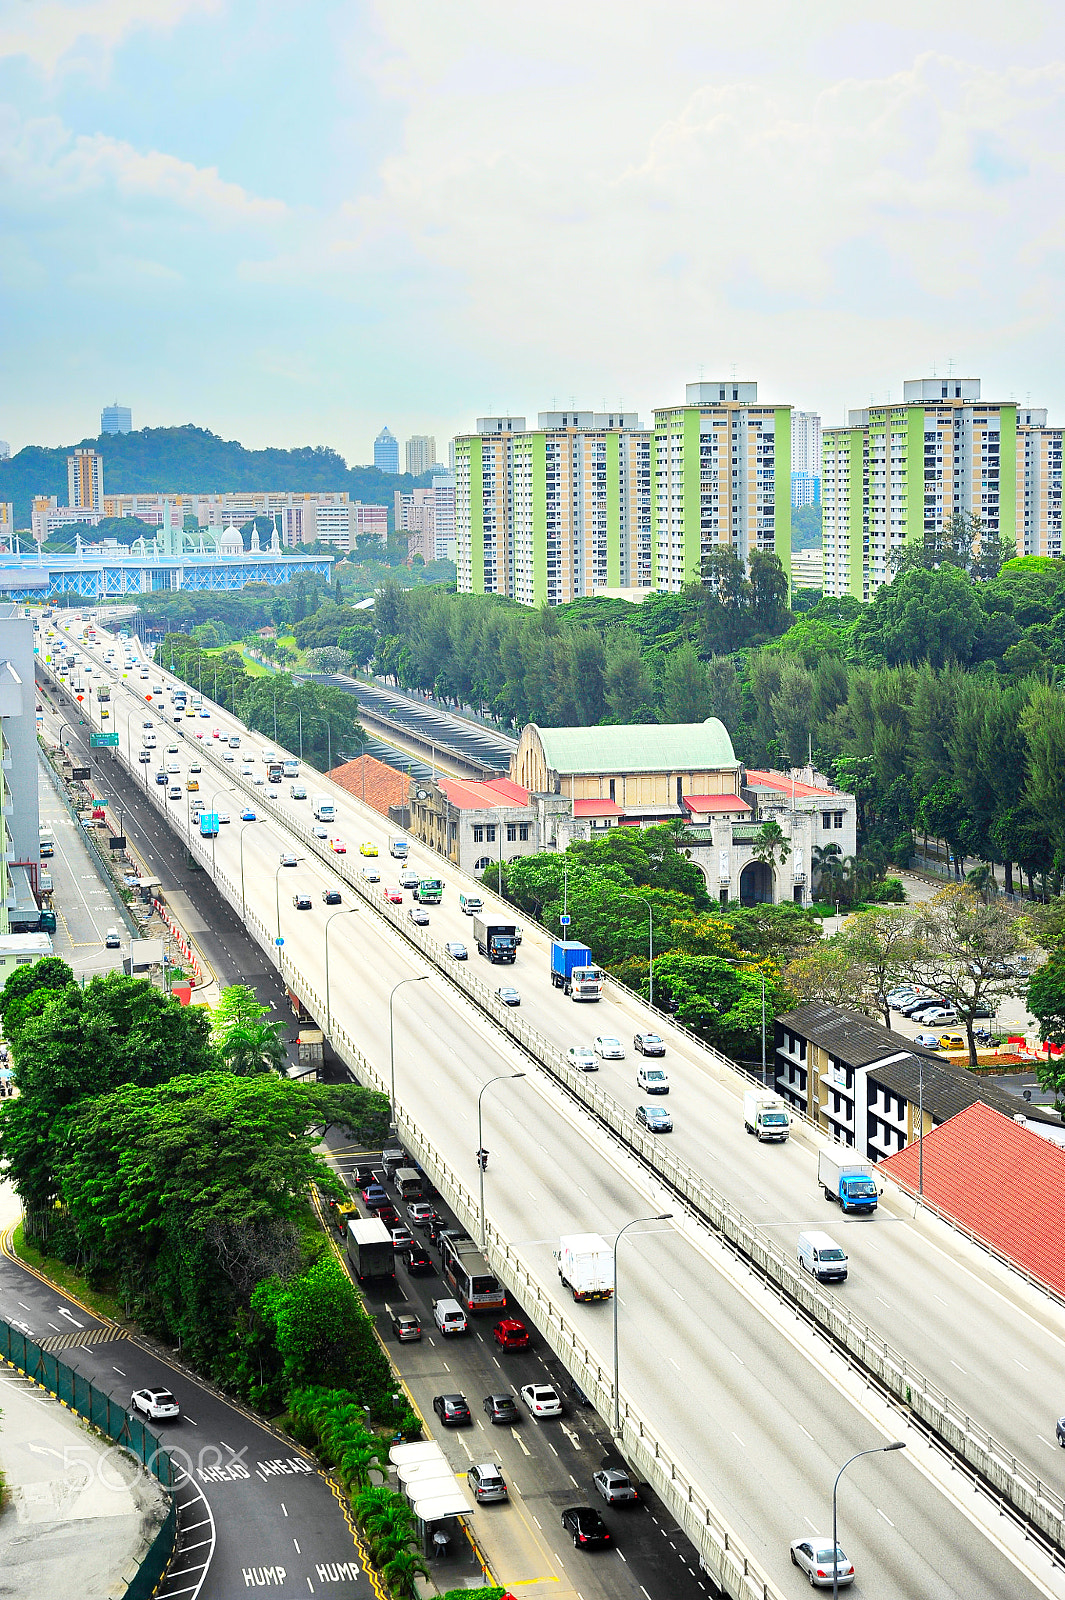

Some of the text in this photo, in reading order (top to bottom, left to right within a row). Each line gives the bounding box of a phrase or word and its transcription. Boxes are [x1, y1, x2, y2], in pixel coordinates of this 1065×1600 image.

[196, 1464, 251, 1483] AHEAD
[256, 1457, 313, 1477] AHEAD
[241, 1566, 287, 1587] HUMP
[315, 1562, 360, 1583] HUMP
